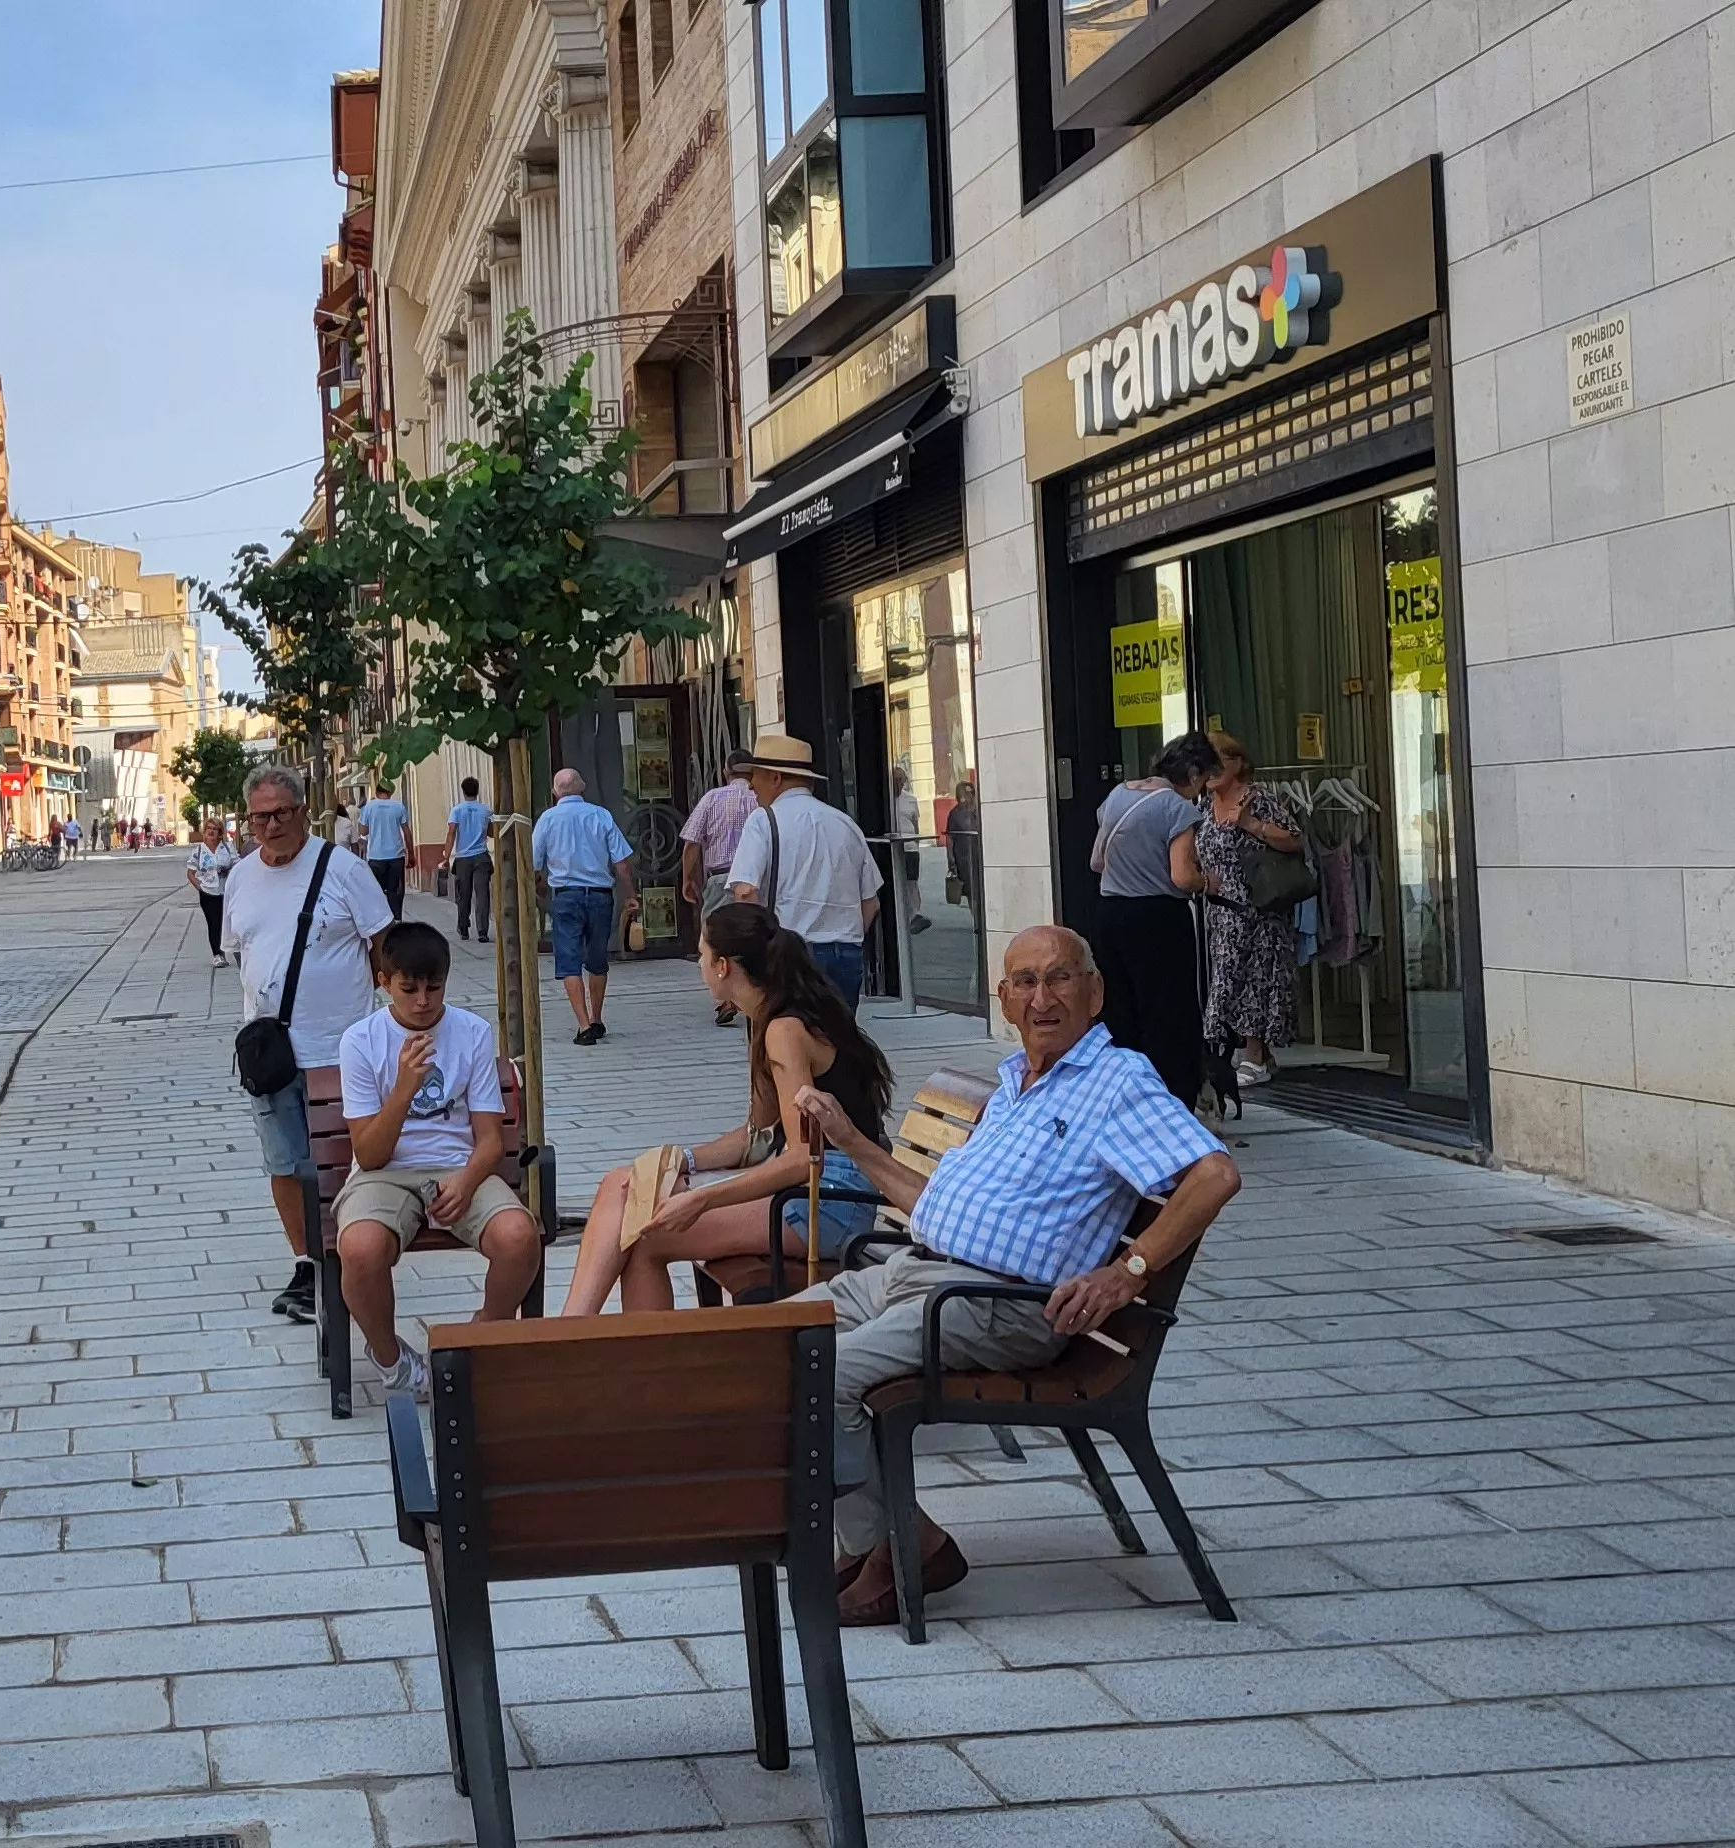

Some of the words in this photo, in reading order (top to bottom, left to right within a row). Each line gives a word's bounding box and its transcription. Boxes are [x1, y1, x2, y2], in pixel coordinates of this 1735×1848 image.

[1571, 319, 1624, 351] PROHIBIDO
[1583, 344, 1614, 368] PEGAR
[1577, 361, 1623, 390] CARTELES
[1572, 381, 1619, 407] RESPONSABLE
[1621, 380, 1630, 391] EL
[1579, 396, 1624, 419] ANUNCIANTE
[1394, 584, 1442, 625] REB
[1114, 636, 1180, 674] REBAJAS
